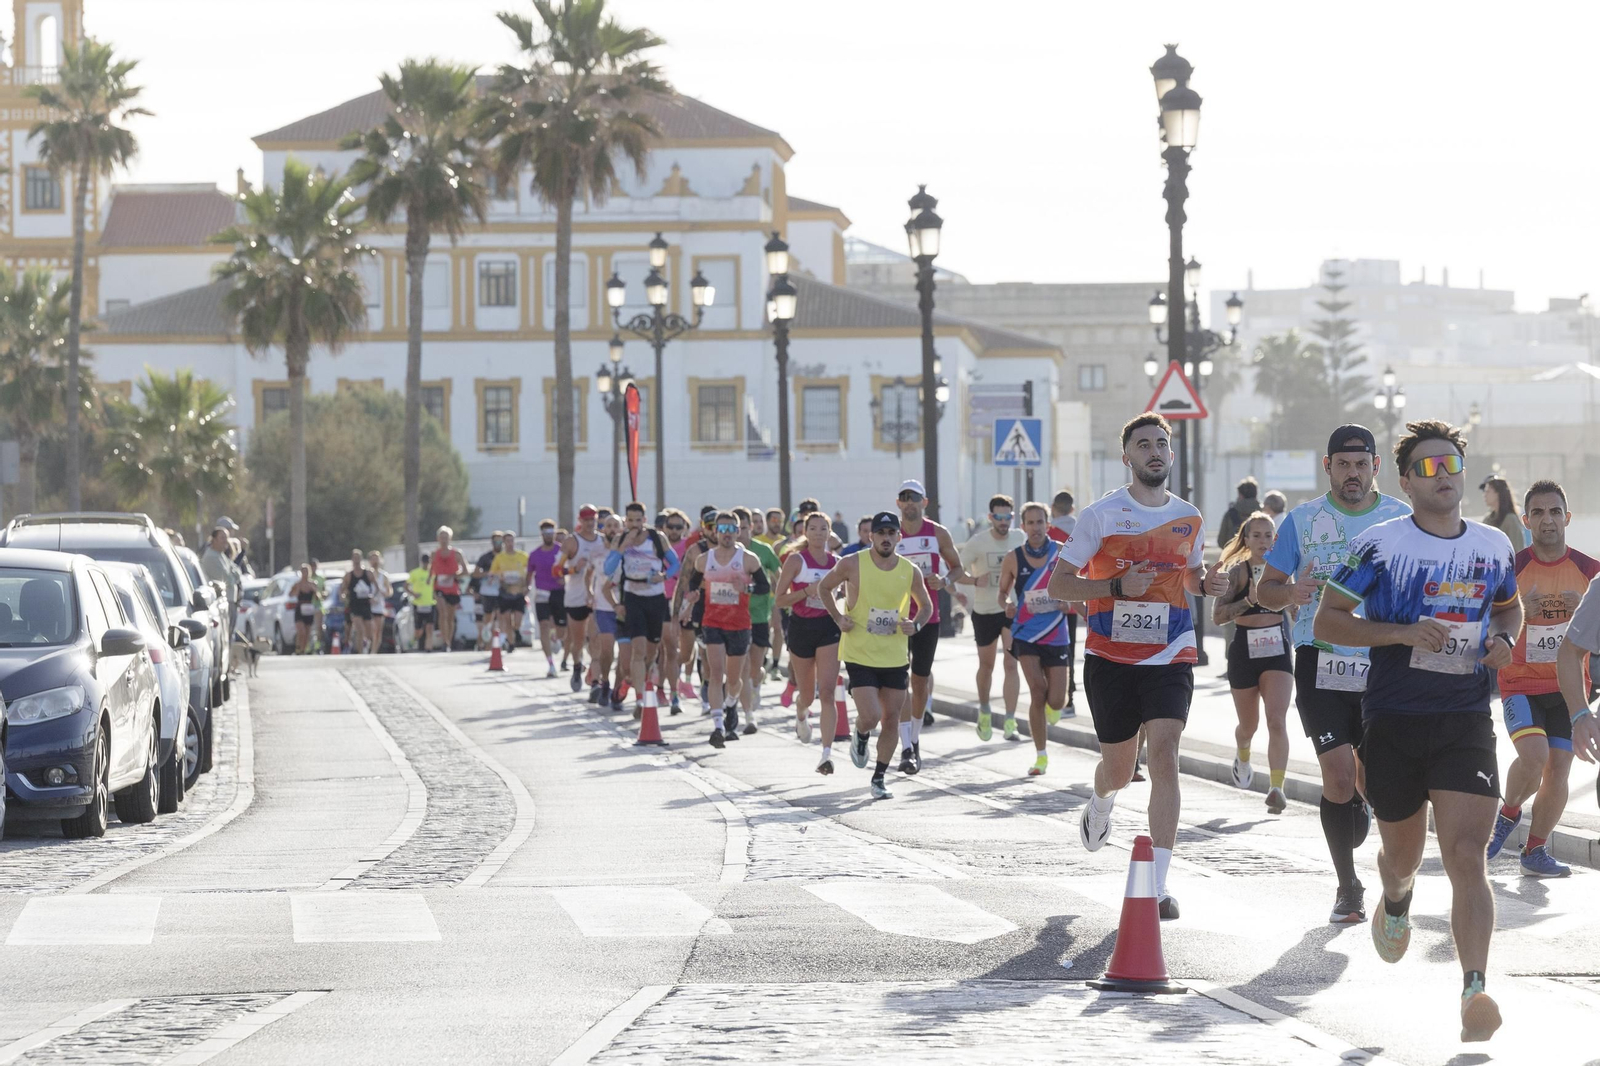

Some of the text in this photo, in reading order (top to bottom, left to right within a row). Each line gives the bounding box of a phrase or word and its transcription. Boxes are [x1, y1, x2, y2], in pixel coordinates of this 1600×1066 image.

[1121, 613, 1162, 630] 2321
[1432, 637, 1470, 657] 97
[1326, 660, 1370, 678] 1017
